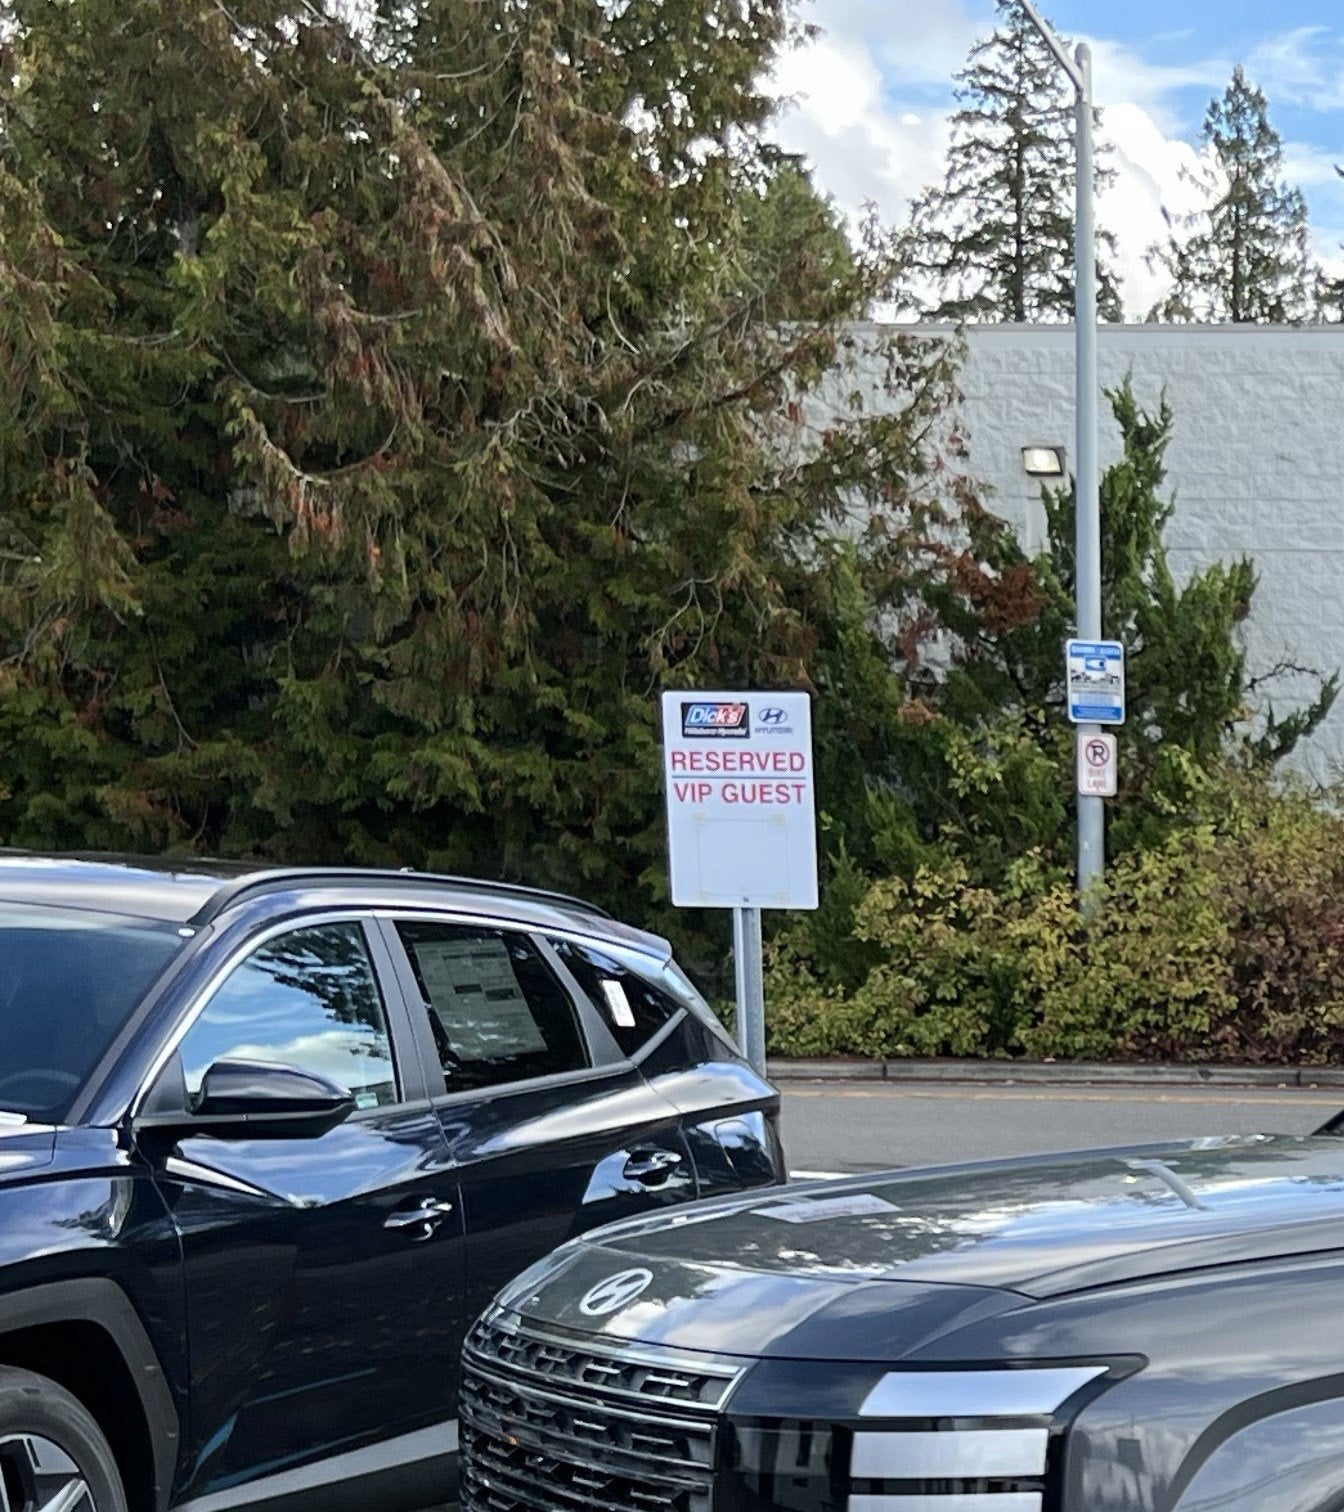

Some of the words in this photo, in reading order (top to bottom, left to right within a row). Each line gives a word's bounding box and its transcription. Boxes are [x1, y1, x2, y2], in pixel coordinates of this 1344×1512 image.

[690, 707, 740, 725] Dick's
[671, 750, 806, 772] RESERVED
[673, 782, 713, 804] VIP
[721, 783, 806, 804] GUEST
